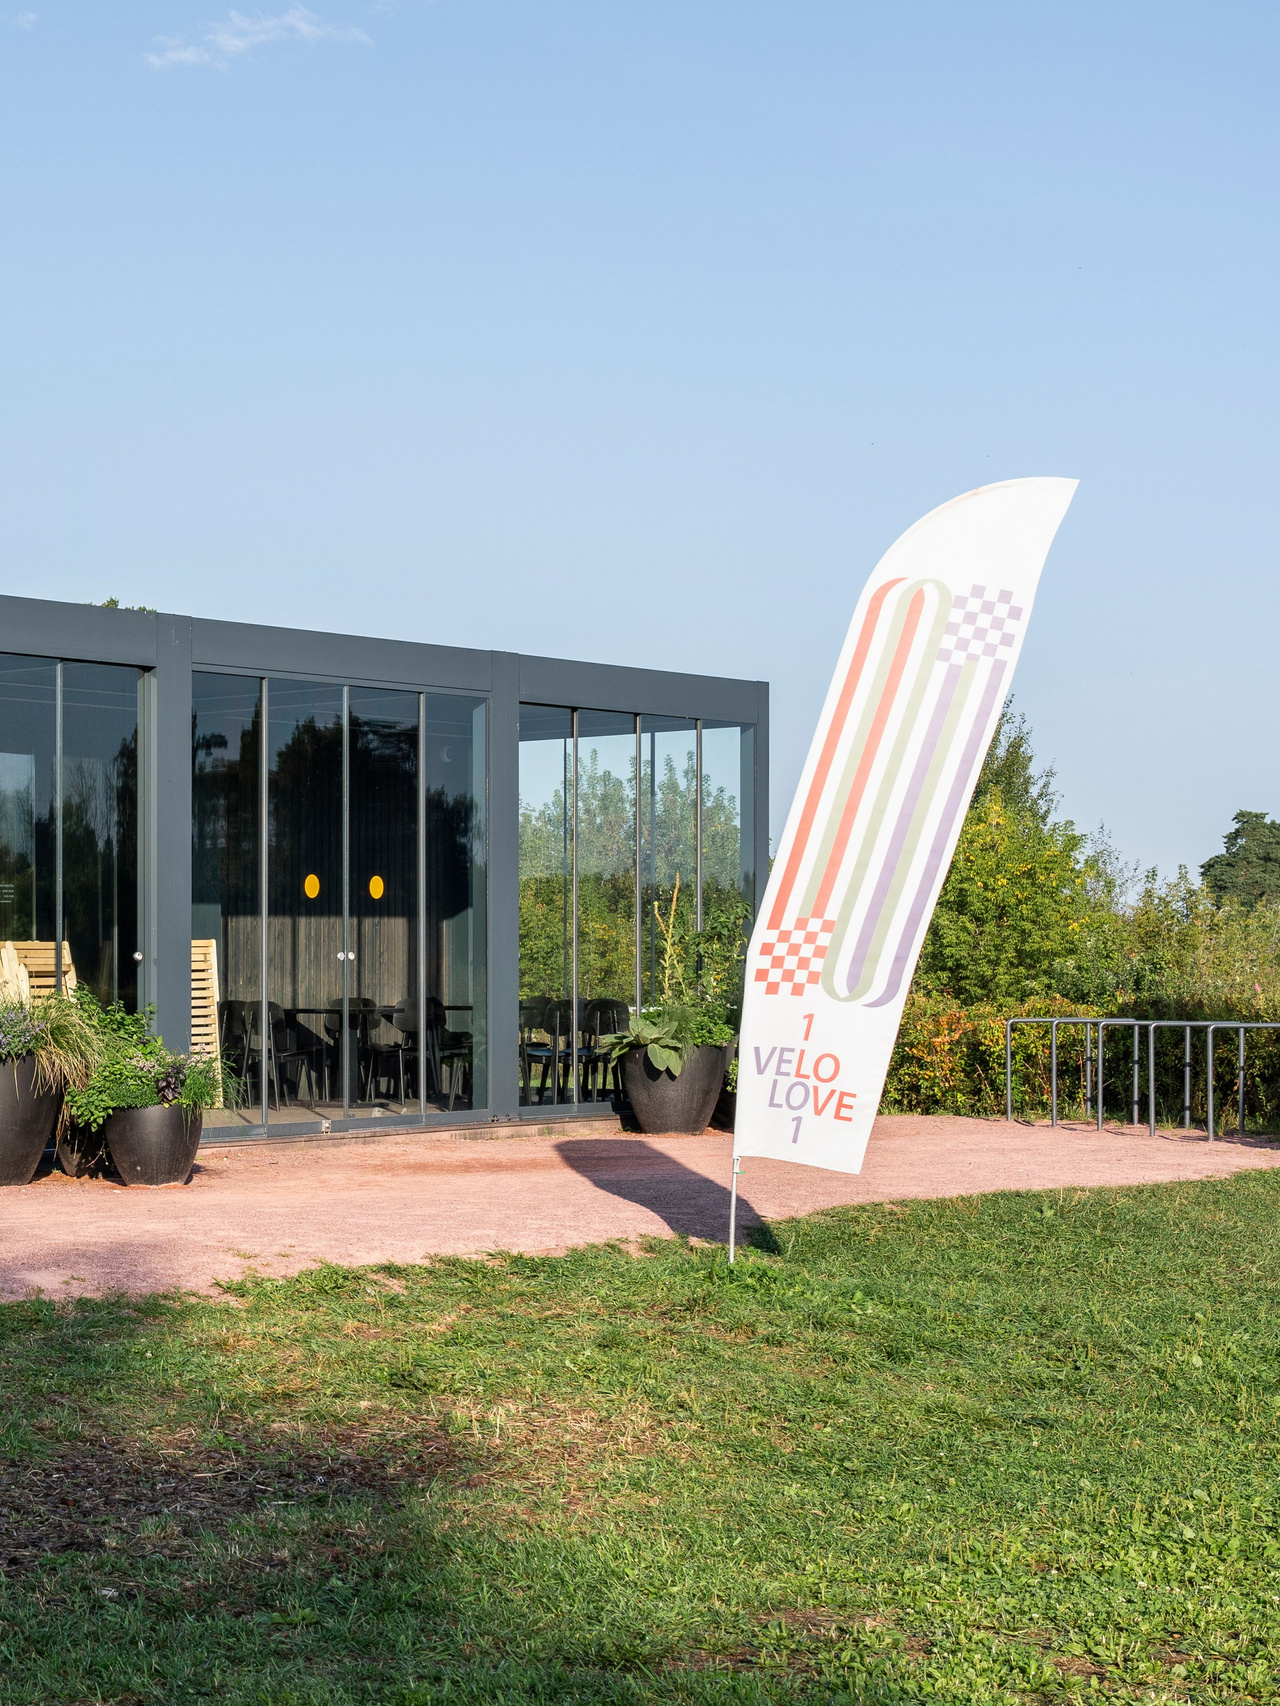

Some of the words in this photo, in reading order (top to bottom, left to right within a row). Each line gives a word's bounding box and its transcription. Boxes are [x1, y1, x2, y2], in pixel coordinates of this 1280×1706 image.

[803, 1013, 814, 1041] 1
[754, 1046, 840, 1083] VELO
[768, 1079, 856, 1122] LOVE
[791, 1116, 803, 1144] 1
